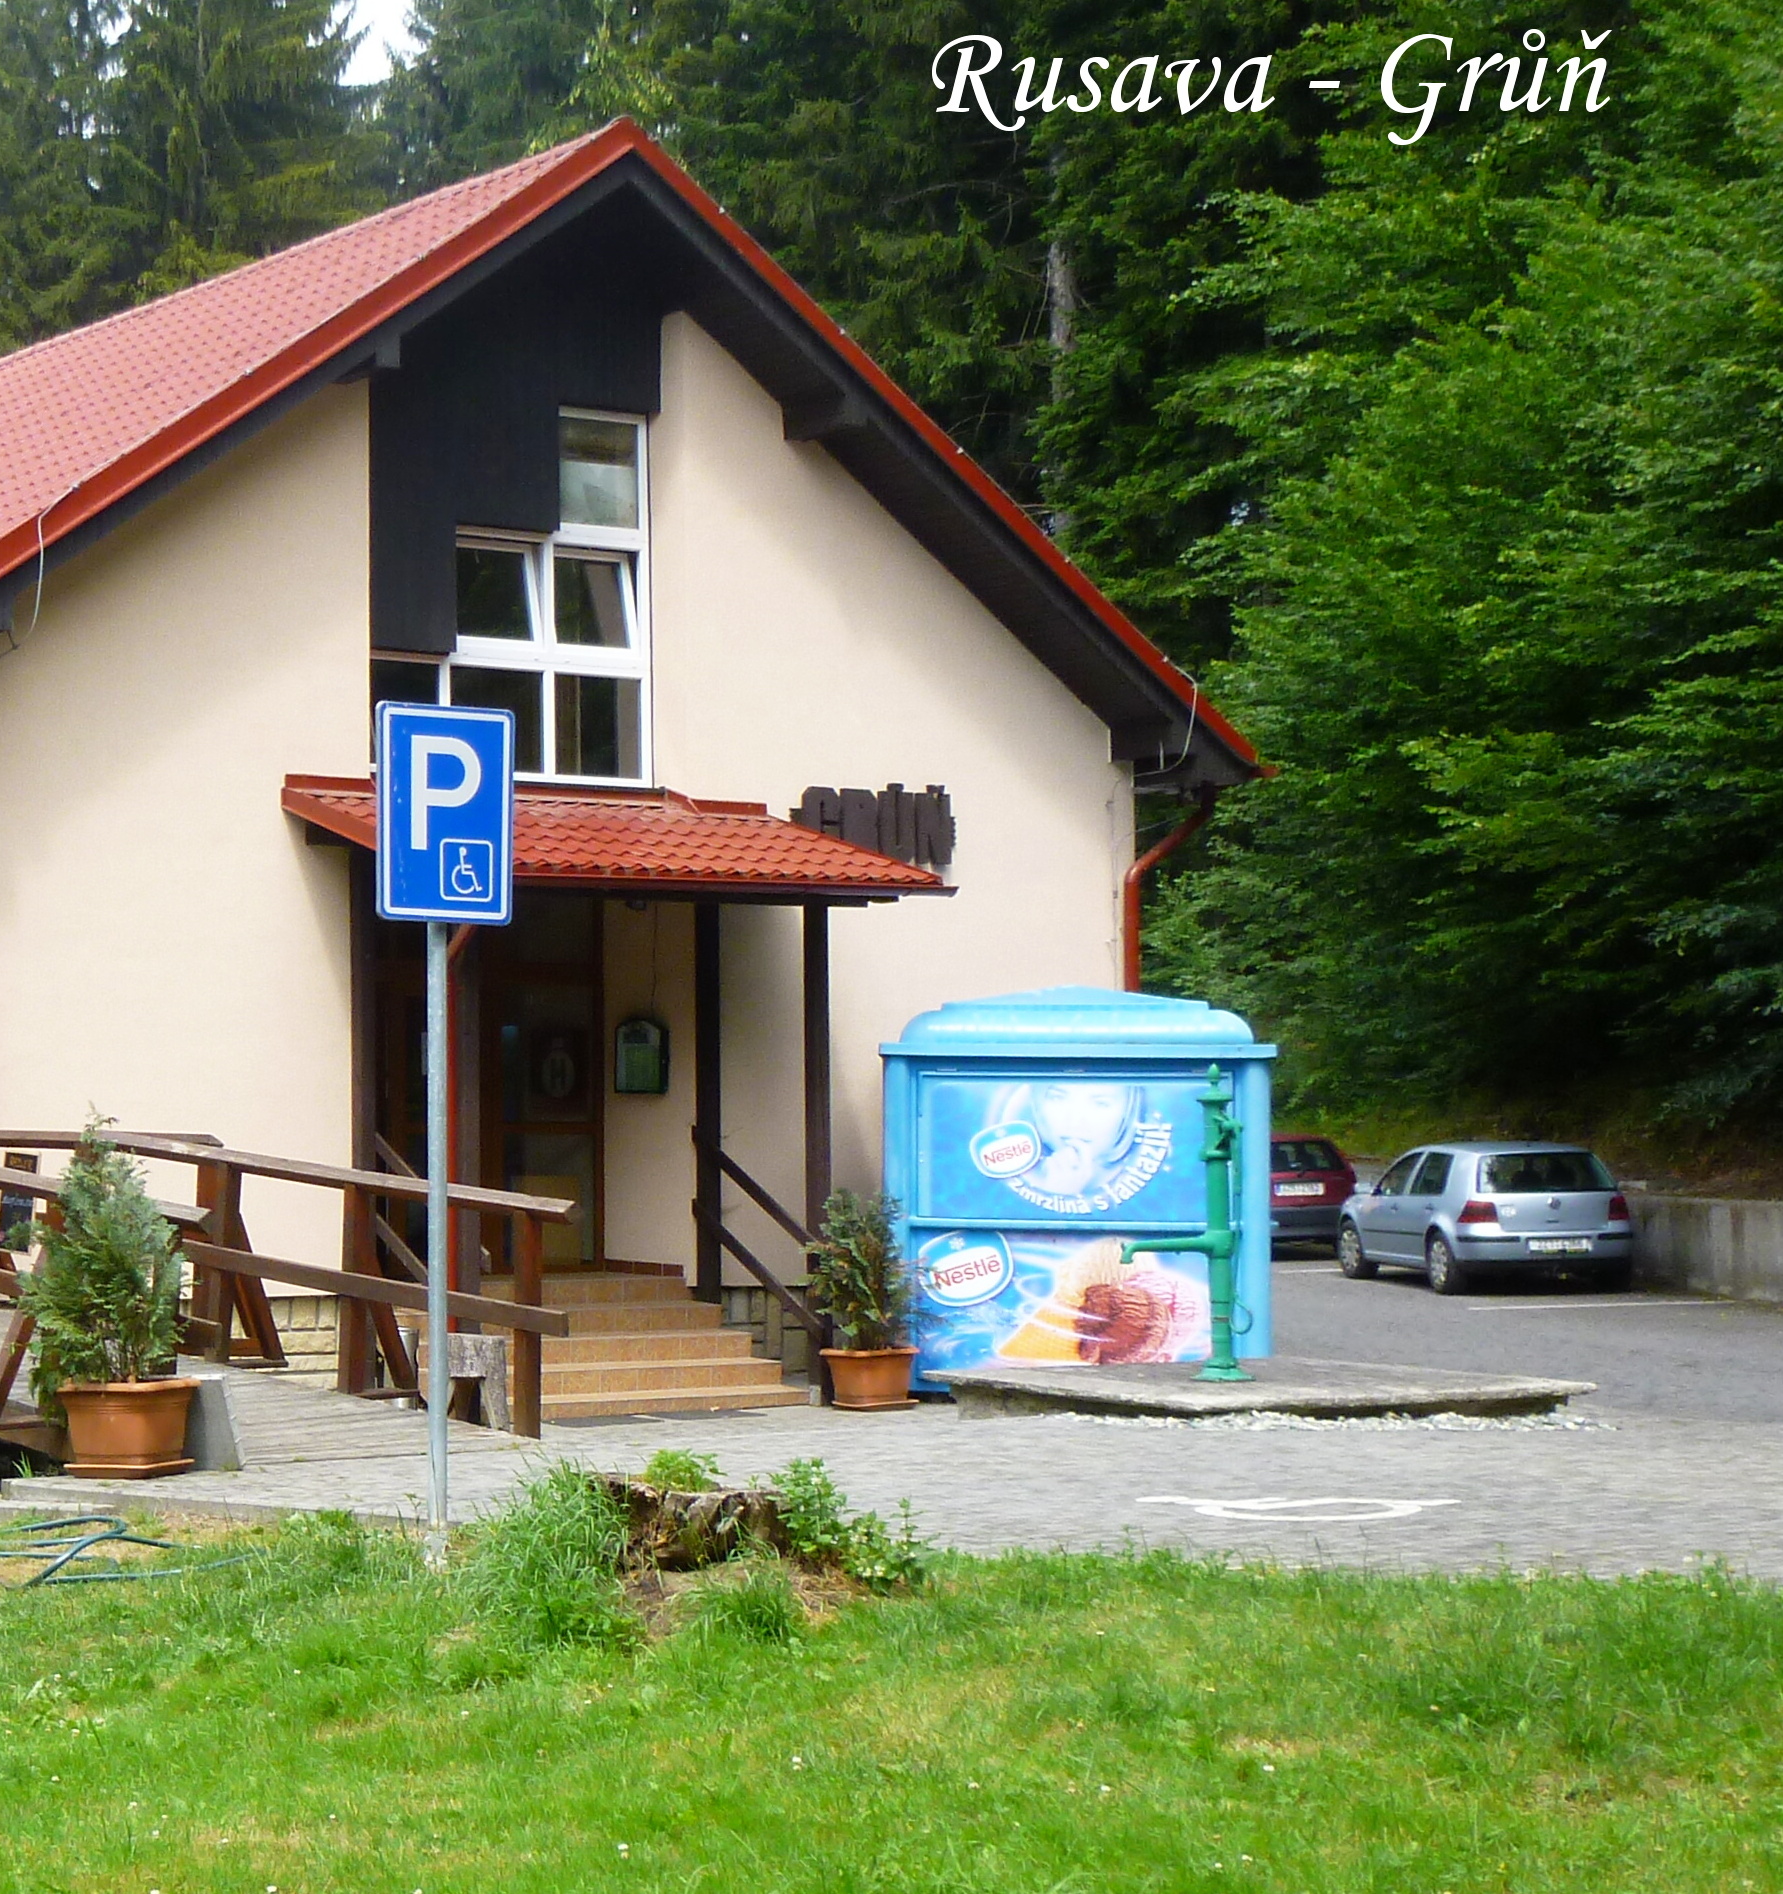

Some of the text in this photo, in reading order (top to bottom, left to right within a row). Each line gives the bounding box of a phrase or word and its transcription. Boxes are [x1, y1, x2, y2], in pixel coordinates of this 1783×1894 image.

[410, 734, 482, 851] P
[982, 1141, 1032, 1167] Nestlé
[933, 1254, 1001, 1290] Nestlé
